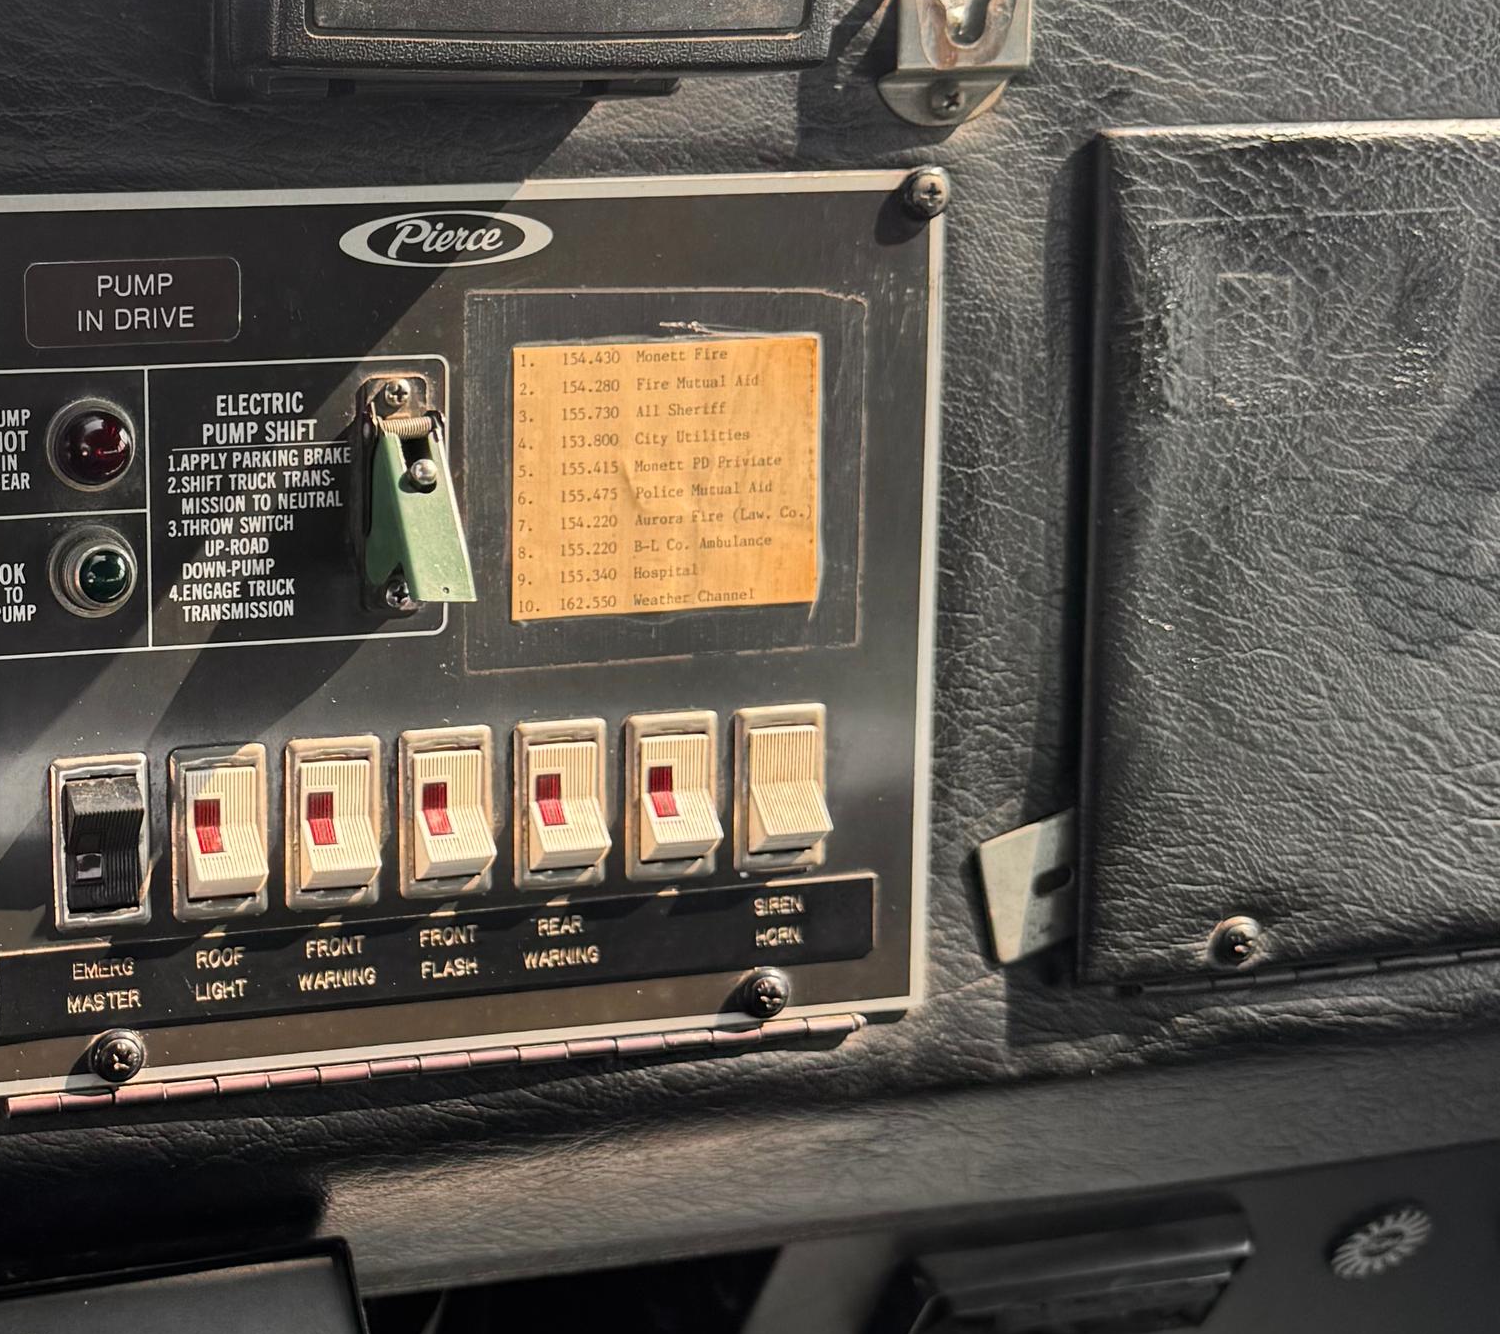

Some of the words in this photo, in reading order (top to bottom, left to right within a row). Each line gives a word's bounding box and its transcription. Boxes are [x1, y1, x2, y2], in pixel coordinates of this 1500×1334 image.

[387, 219, 504, 259] Pierce
[97, 273, 173, 297] PUMP
[78, 309, 103, 331] IN
[115, 306, 194, 330] DRIVE
[520, 354, 534, 367] 1.
[562, 350, 620, 365] 154.430
[636, 349, 686, 363] Monett
[694, 347, 728, 361] Fire
[519, 383, 535, 396] 2.
[562, 379, 620, 394] 154.280
[636, 378, 669, 391] Fire
[676, 375, 725, 389] Mutual
[735, 374, 759, 387] Aid
[216, 391, 304, 417] ELECTRIC
[518, 410, 534, 423] 3.
[562, 406, 620, 421] 155.730
[636, 404, 659, 417] All
[668, 402, 727, 417] Sheriff
[202, 421, 258, 446] PUMP
[265, 419, 318, 442] SHIFT
[518, 438, 534, 450] 4.
[561, 433, 619, 449] 153.800
[635, 431, 668, 447] City
[676, 429, 750, 443] Utilities
[1, 454, 17, 472] IN
[233, 449, 299, 468] PARKING
[303, 447, 352, 465] BRAKE
[518, 465, 533, 478] 5.
[561, 461, 619, 475] 155.415
[634, 459, 684, 472] Monett
[693, 456, 709, 470] PD
[229, 471, 276, 491] TRUCK
[283, 469, 335, 488] TRANS-
[181, 495, 246, 515] MISSION
[252, 494, 271, 511] TO
[278, 490, 343, 509] NEUTRAL
[518, 492, 533, 505] 6.
[560, 488, 618, 503] 155.475
[635, 485, 684, 499] Police
[691, 482, 740, 496] Mutual
[748, 480, 773, 493] Aid
[239, 515, 294, 534] SWITCH
[518, 519, 532, 532] 7.
[561, 515, 618, 530] 154.220
[635, 513, 683, 526] Aurora
[691, 510, 724, 523] Fire
[733, 508, 771, 524] (Law.
[779, 505, 812, 521] Co.)
[204, 537, 269, 557] UP-ROAD
[518, 546, 533, 559] 8.
[560, 541, 617, 557] 155.220
[634, 540, 659, 553] B-L
[666, 538, 690, 551] Co.
[699, 535, 772, 549] Ambulance
[0, 563, 26, 586] OK
[182, 558, 275, 580] DOWN-PUMP
[517, 573, 532, 586] 9.
[560, 568, 617, 584] 155.340
[633, 563, 698, 581] Hospital
[4, 586, 24, 604] TO
[248, 578, 295, 596] TRUCK
[182, 599, 294, 622] TRANSMISSION
[518, 600, 540, 613] 10.
[560, 595, 617, 611] 162.550
[633, 593, 691, 606] Weather
[697, 588, 754, 603] Channel
[754, 895, 805, 917] SIREN
[419, 924, 478, 948] FRONT
[537, 915, 584, 937] REAR
[755, 925, 805, 947] HORN
[196, 946, 246, 969] ROOF
[306, 934, 366, 959] FRONT
[523, 945, 599, 969] WARNING
[72, 956, 135, 981] EMERG
[421, 956, 478, 979] FLASH
[195, 978, 248, 1002] LIGHT
[298, 967, 377, 992] WARNING
[67, 988, 142, 1014] MASTER
